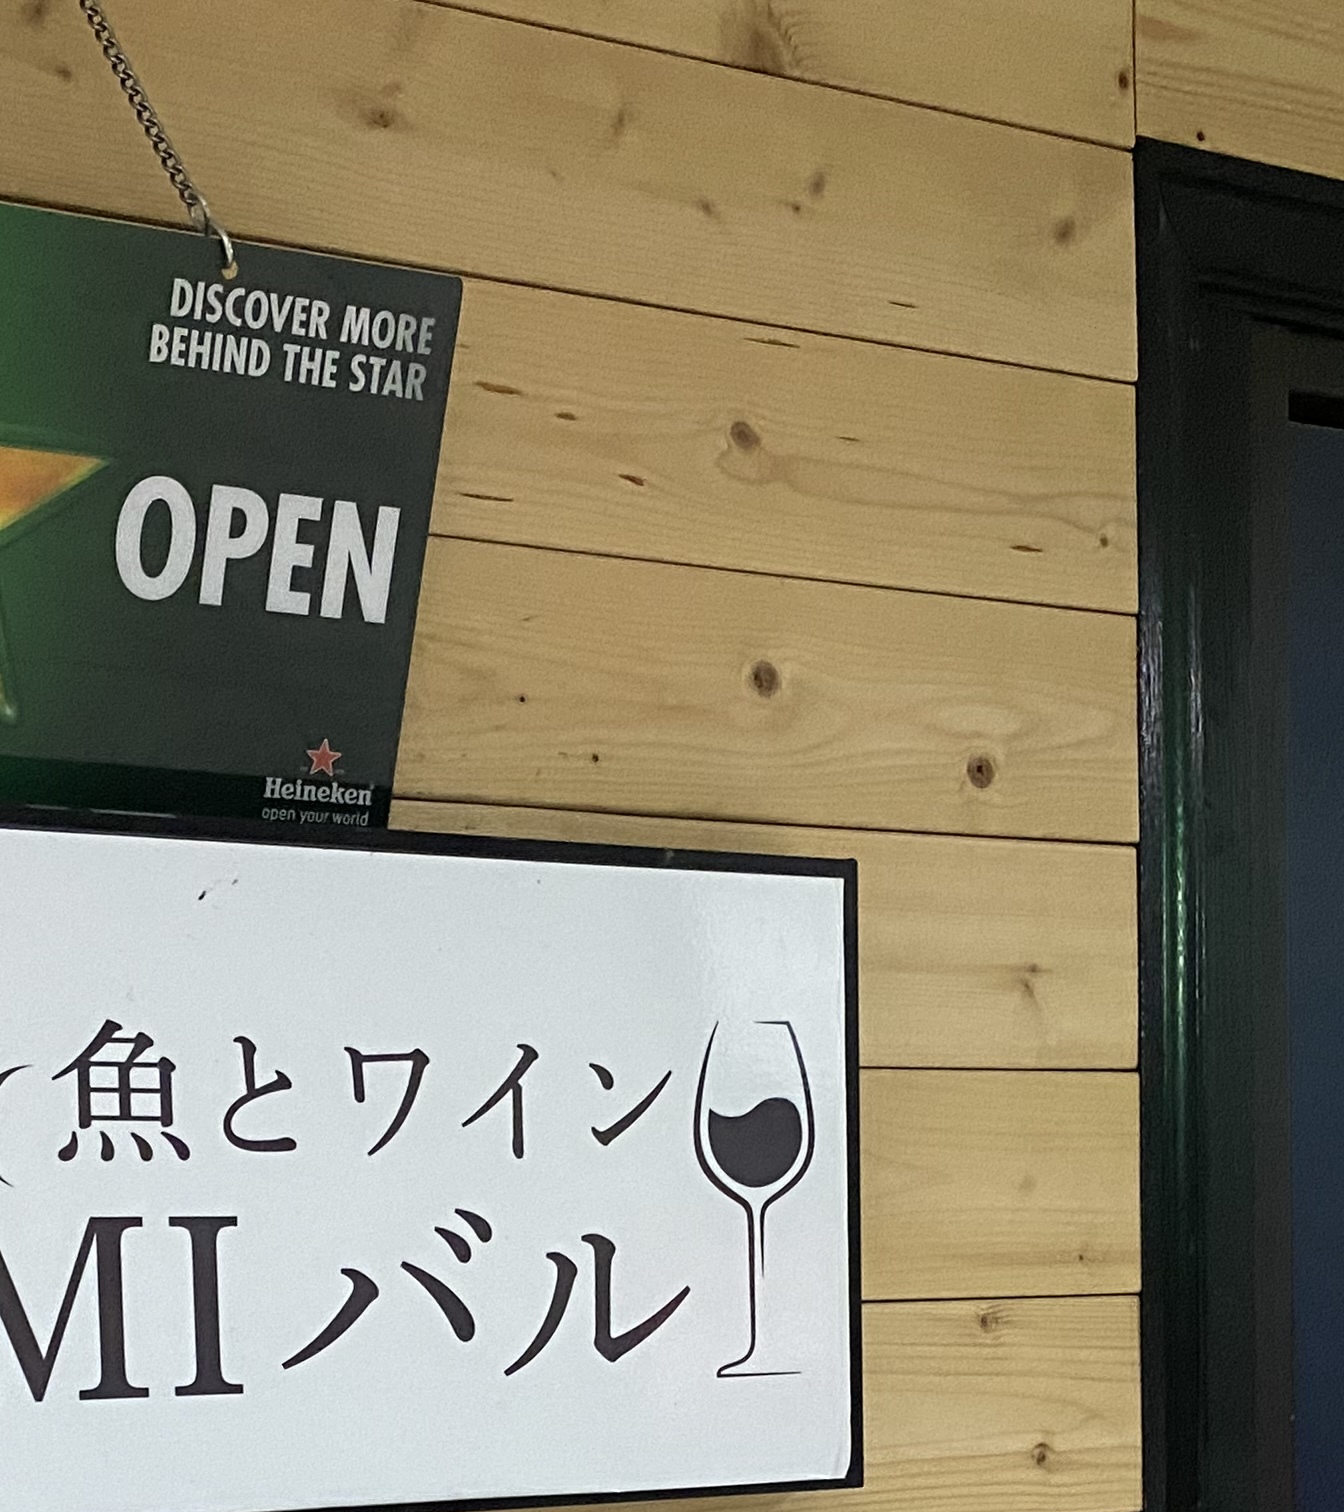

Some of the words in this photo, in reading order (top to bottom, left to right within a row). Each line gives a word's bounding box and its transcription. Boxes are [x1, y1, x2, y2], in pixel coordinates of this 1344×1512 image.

[170, 278, 330, 340] DISCOVER
[340, 304, 436, 354] MORE
[149, 324, 270, 377] BEHIND
[283, 343, 340, 388] THE
[349, 354, 427, 401] STAR
[114, 475, 402, 624] OPEN
[262, 807, 296, 820] open
[300, 810, 330, 824] your
[332, 811, 369, 826] world
[263, 777, 372, 805] Heineken
[52, 1019, 674, 1164] 魚とワイン
